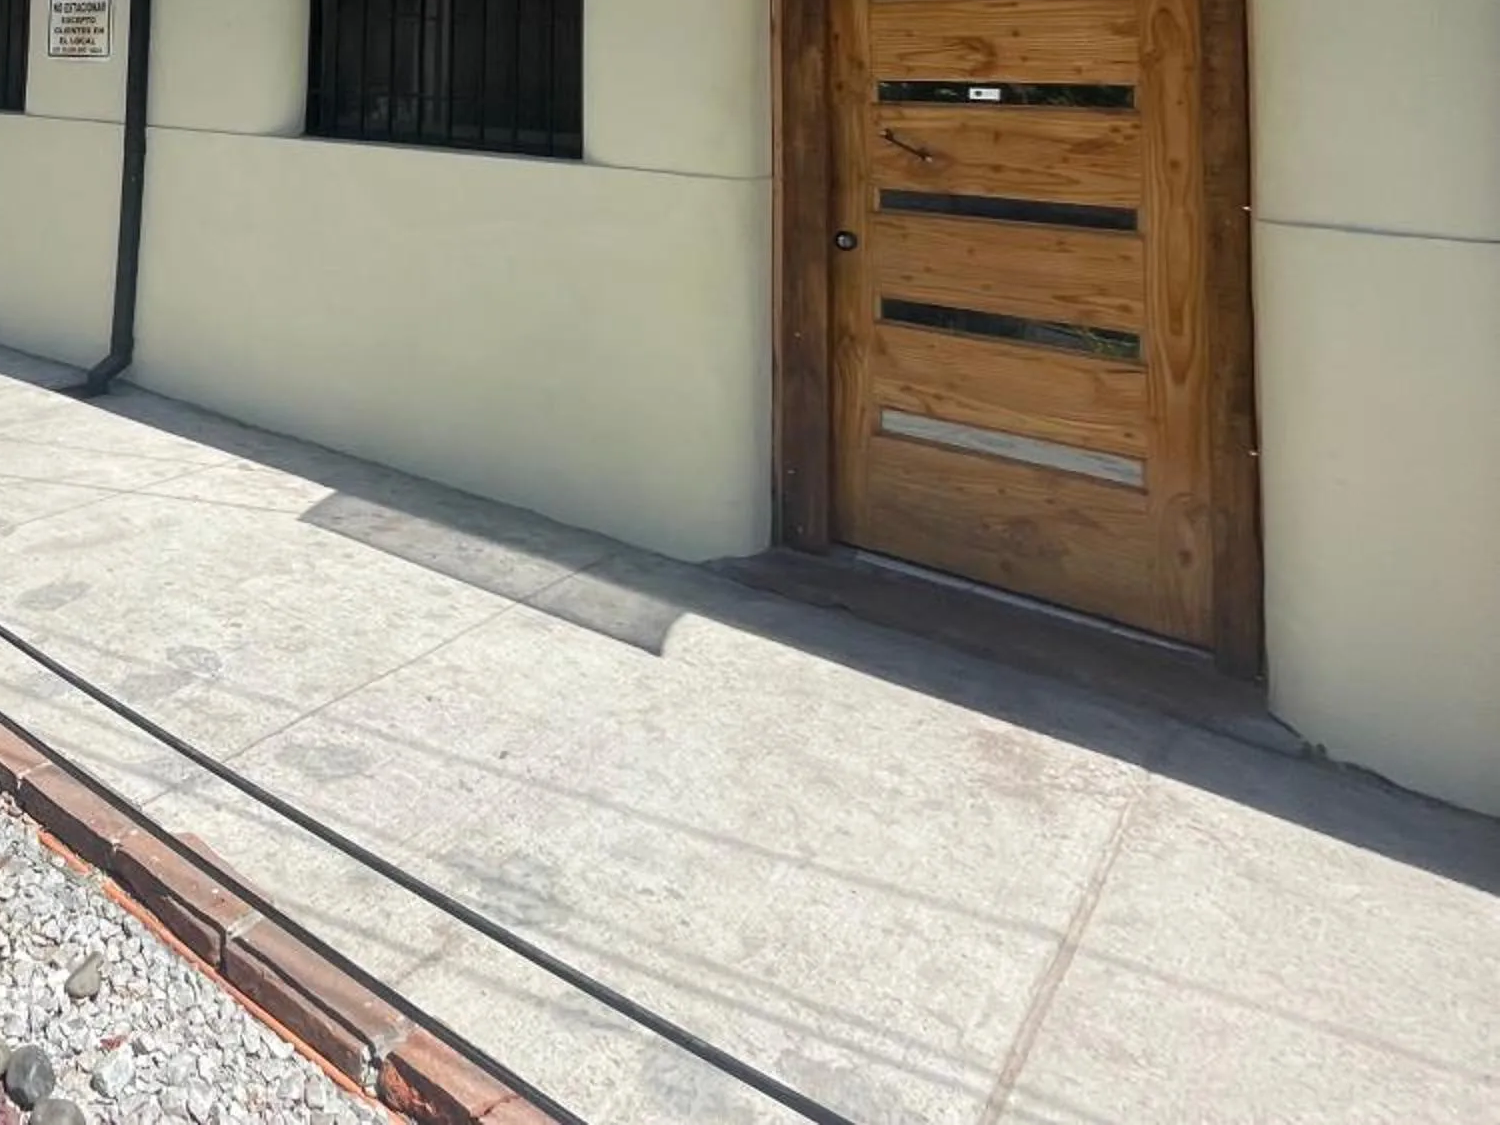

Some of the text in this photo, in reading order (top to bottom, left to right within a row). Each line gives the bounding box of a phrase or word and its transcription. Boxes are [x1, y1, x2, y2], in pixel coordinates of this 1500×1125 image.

[53, 1, 107, 14] NO ESTACIONAR
[61, 16, 96, 25] EXCEPTO
[54, 26, 91, 34] CLIENTES
[69, 36, 96, 46] LOCAL
